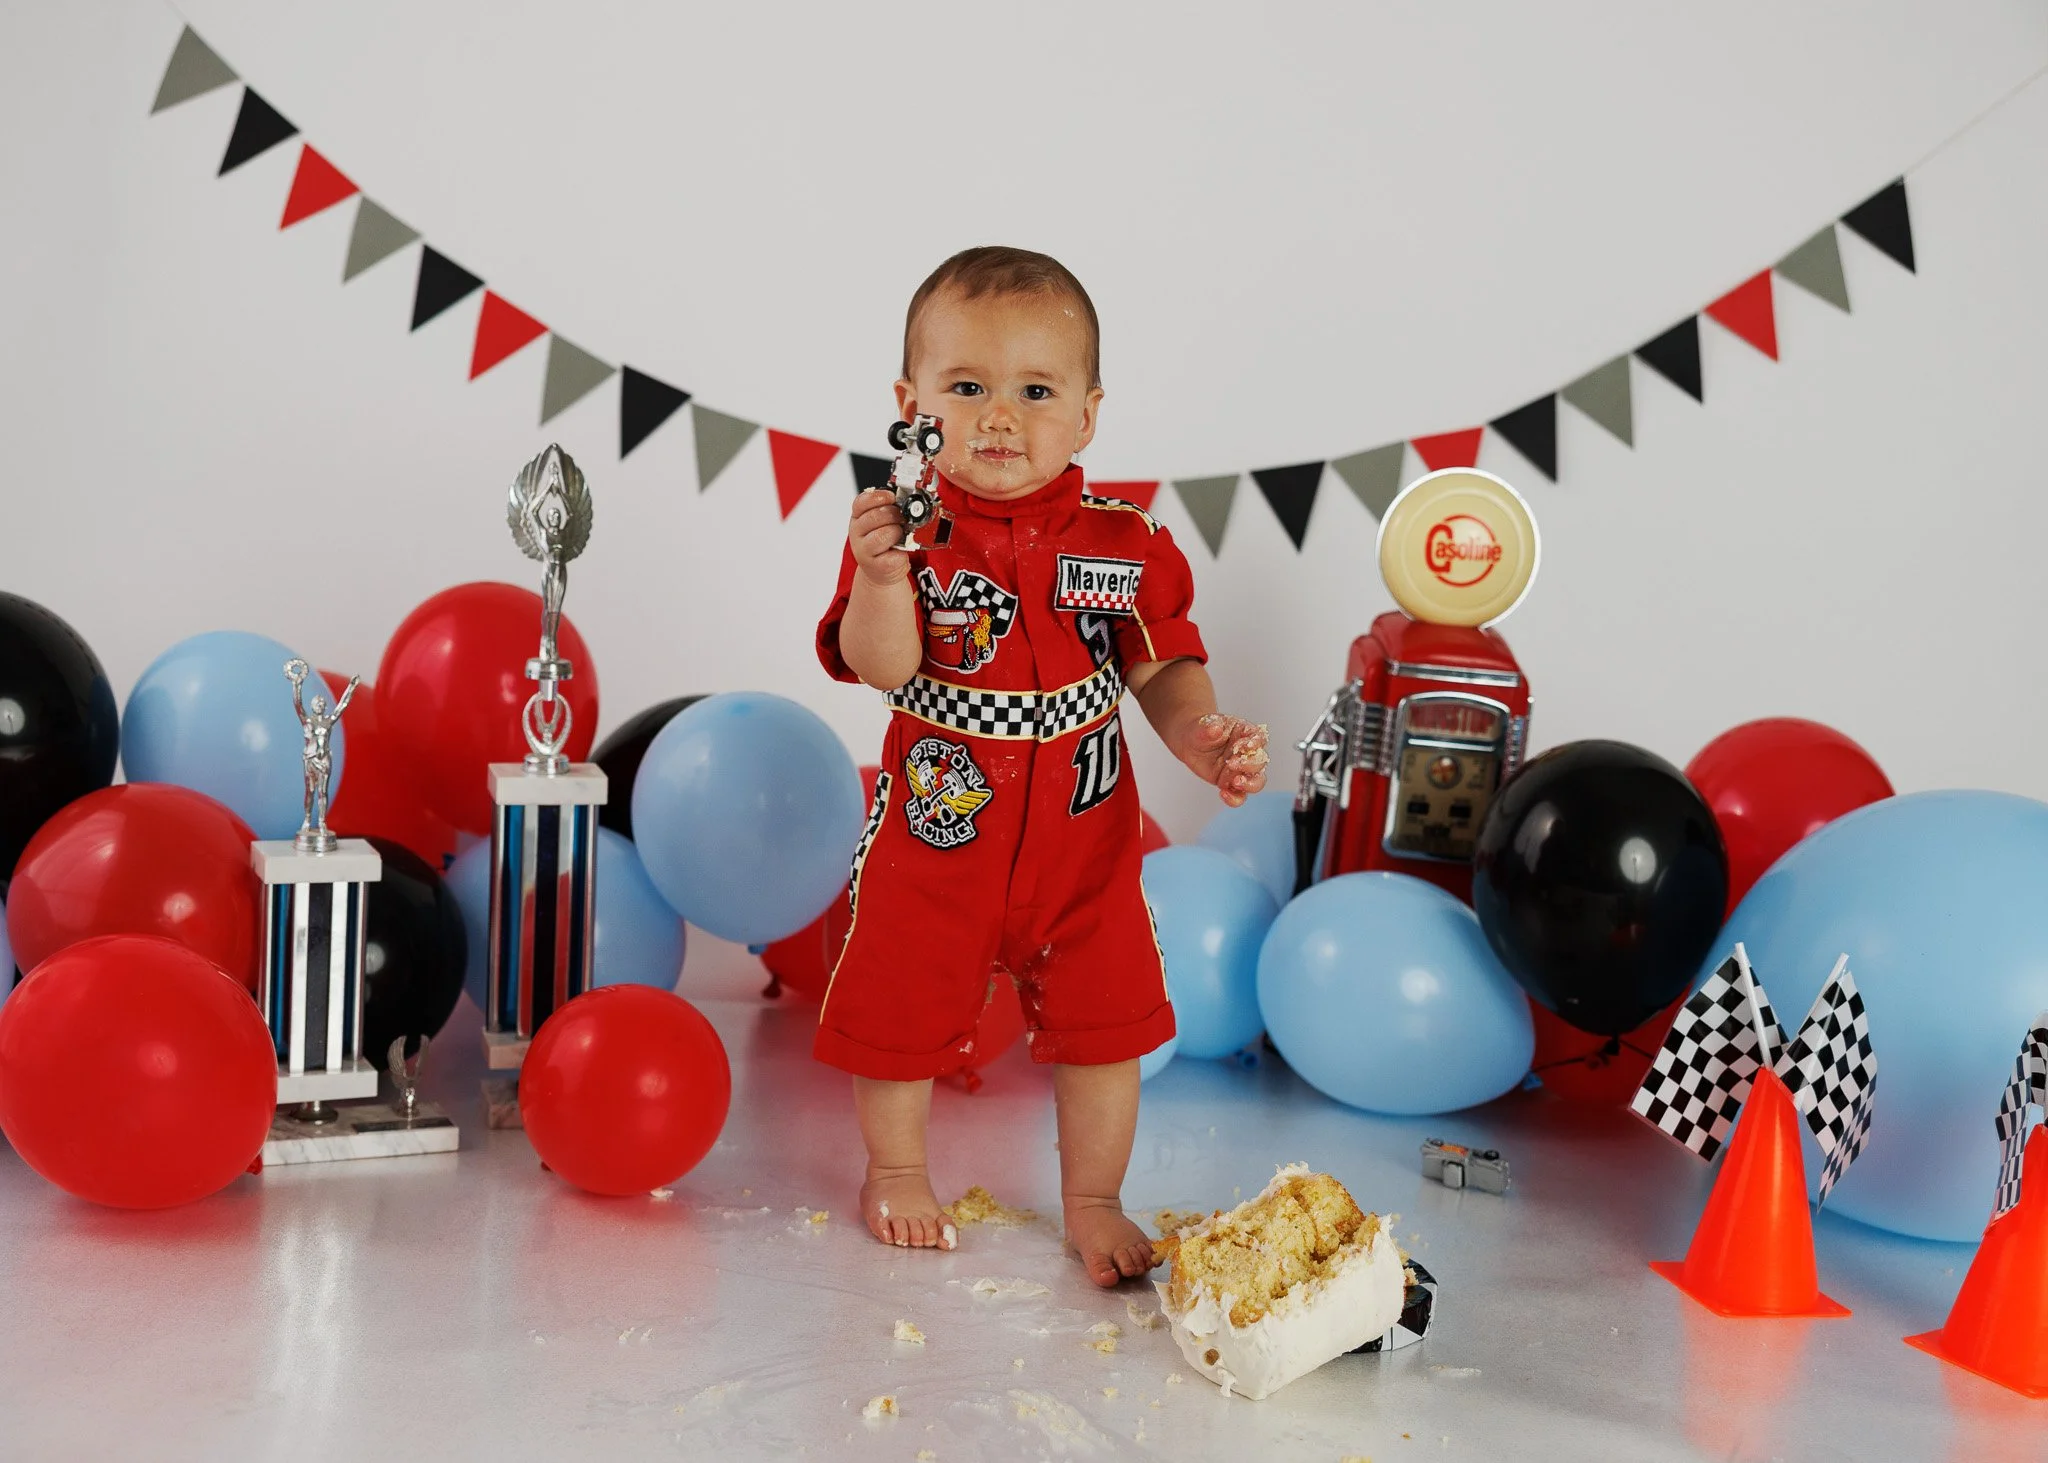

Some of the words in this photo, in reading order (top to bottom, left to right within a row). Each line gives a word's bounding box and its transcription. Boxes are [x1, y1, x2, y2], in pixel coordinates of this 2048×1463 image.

[912, 742, 979, 788] PISTON
[1078, 716, 1120, 807] 10
[908, 801, 973, 843] RACING
